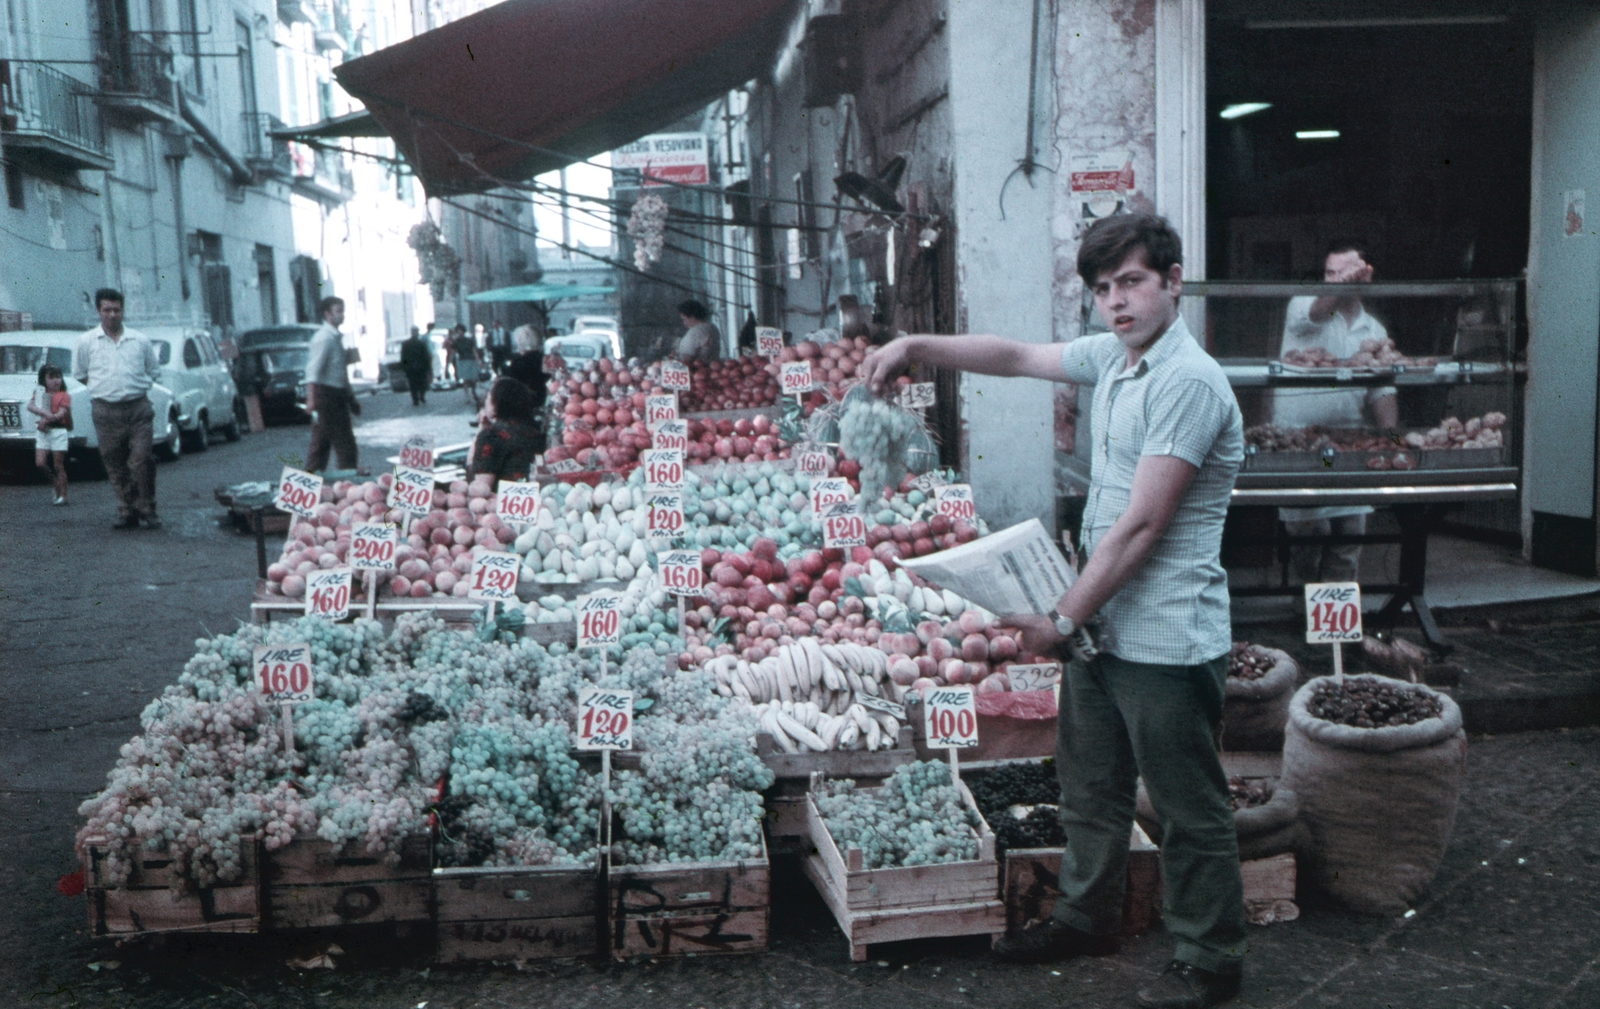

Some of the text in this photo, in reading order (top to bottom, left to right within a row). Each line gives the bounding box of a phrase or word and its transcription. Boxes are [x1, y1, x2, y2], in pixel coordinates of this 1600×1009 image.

[759, 338, 782, 351] 595
[664, 371, 688, 386] 395
[785, 373, 810, 388] 200
[648, 397, 673, 406] LIRE
[658, 423, 685, 433] LIRE
[648, 452, 680, 462] LIRE
[800, 453, 826, 472] 160
[286, 472, 321, 490] LIRE
[398, 470, 433, 487] LIRE
[648, 462, 682, 484] 160
[393, 481, 430, 507] 240
[503, 486, 537, 496] LIRE
[812, 481, 845, 492] LIRE
[940, 489, 968, 501] LIRE
[280, 482, 317, 510] 200
[647, 496, 680, 507] LIRE
[499, 495, 535, 517] 160
[824, 503, 857, 518] LIRE
[941, 500, 974, 519] 280
[647, 507, 683, 530] 120
[355, 526, 394, 539] LIRE
[826, 517, 863, 540] 120
[353, 538, 393, 562] 200
[477, 555, 516, 568] LIRE
[660, 554, 700, 565] LIRE
[309, 573, 351, 587] LIRE
[472, 565, 515, 592] 120
[663, 566, 700, 588] 160
[309, 585, 348, 613] 160
[1310, 588, 1356, 602] LIRE
[581, 597, 618, 611] LIRE
[580, 609, 617, 639] 160
[1310, 602, 1359, 633] 140
[258, 648, 306, 664] LIRE
[259, 663, 309, 694] 160
[583, 692, 630, 709] LIRE
[927, 691, 970, 706] LIRE
[581, 706, 628, 738] 120
[929, 706, 974, 739] 100
